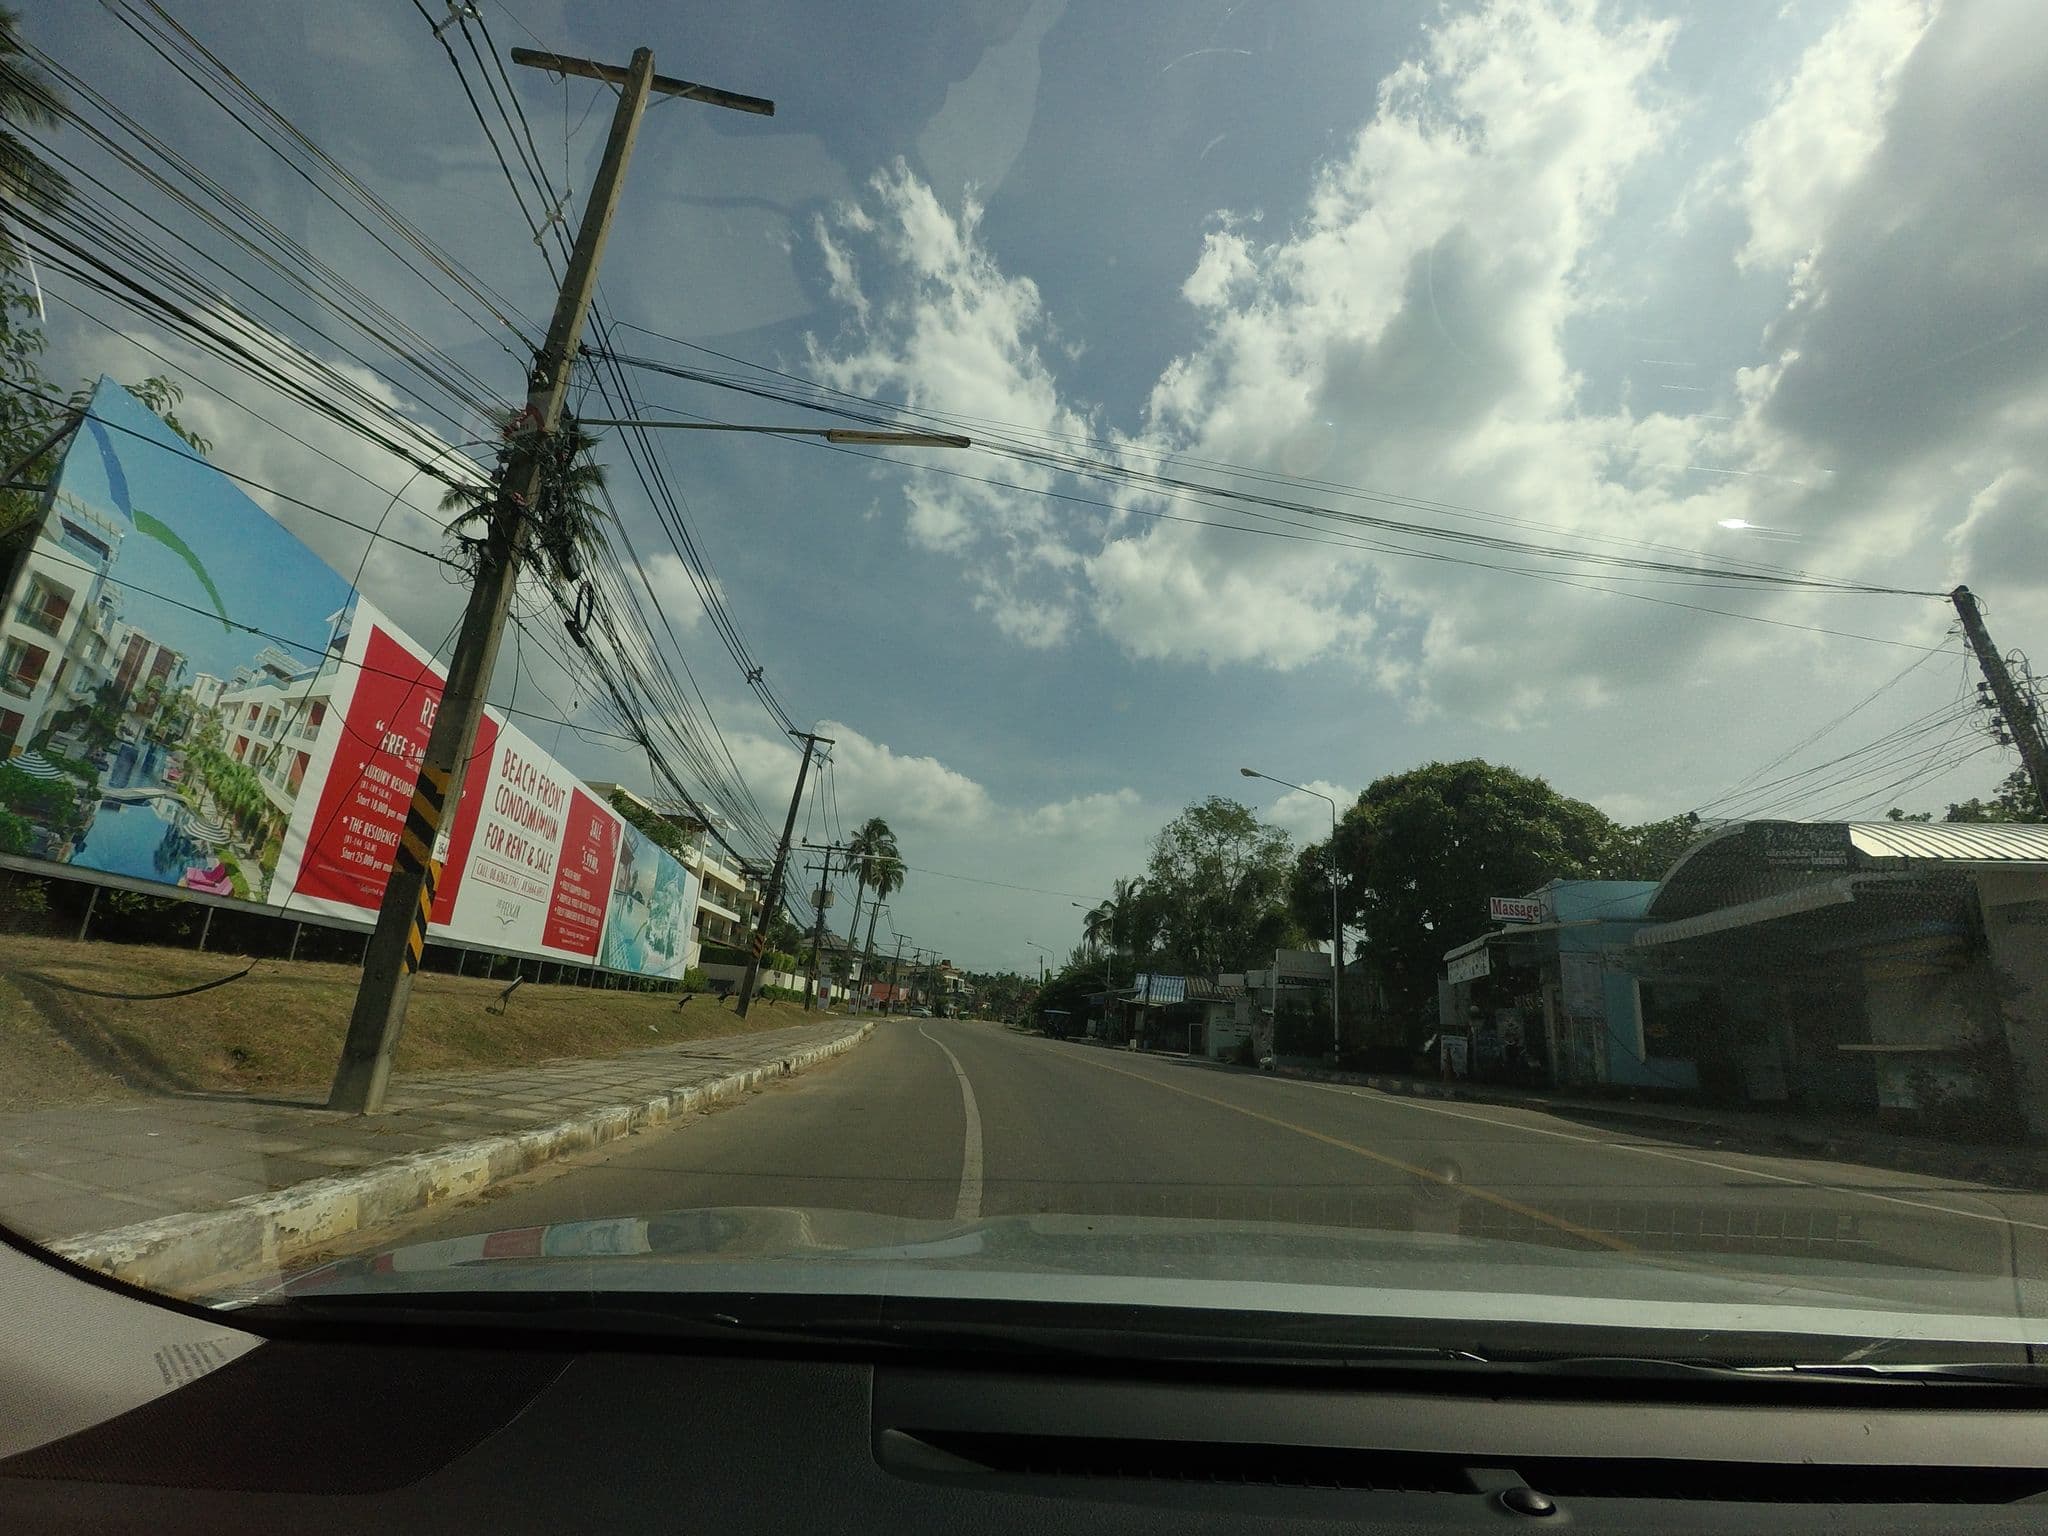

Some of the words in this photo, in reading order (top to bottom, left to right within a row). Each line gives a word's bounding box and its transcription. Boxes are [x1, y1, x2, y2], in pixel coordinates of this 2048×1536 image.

[381, 731, 408, 760] FREE
[364, 765, 392, 786] LUXURY
[502, 747, 537, 797] BEACH
[537, 774, 566, 816] FRONT
[495, 784, 559, 843] CONDOMINIUM
[349, 816, 364, 834] THE
[363, 822, 398, 847] RESIDENCE
[484, 822, 504, 853] FOR
[505, 833, 528, 863] RENT
[527, 846, 535, 866] &
[534, 847, 553, 875] SALE
[1492, 899, 1539, 921] Massage
